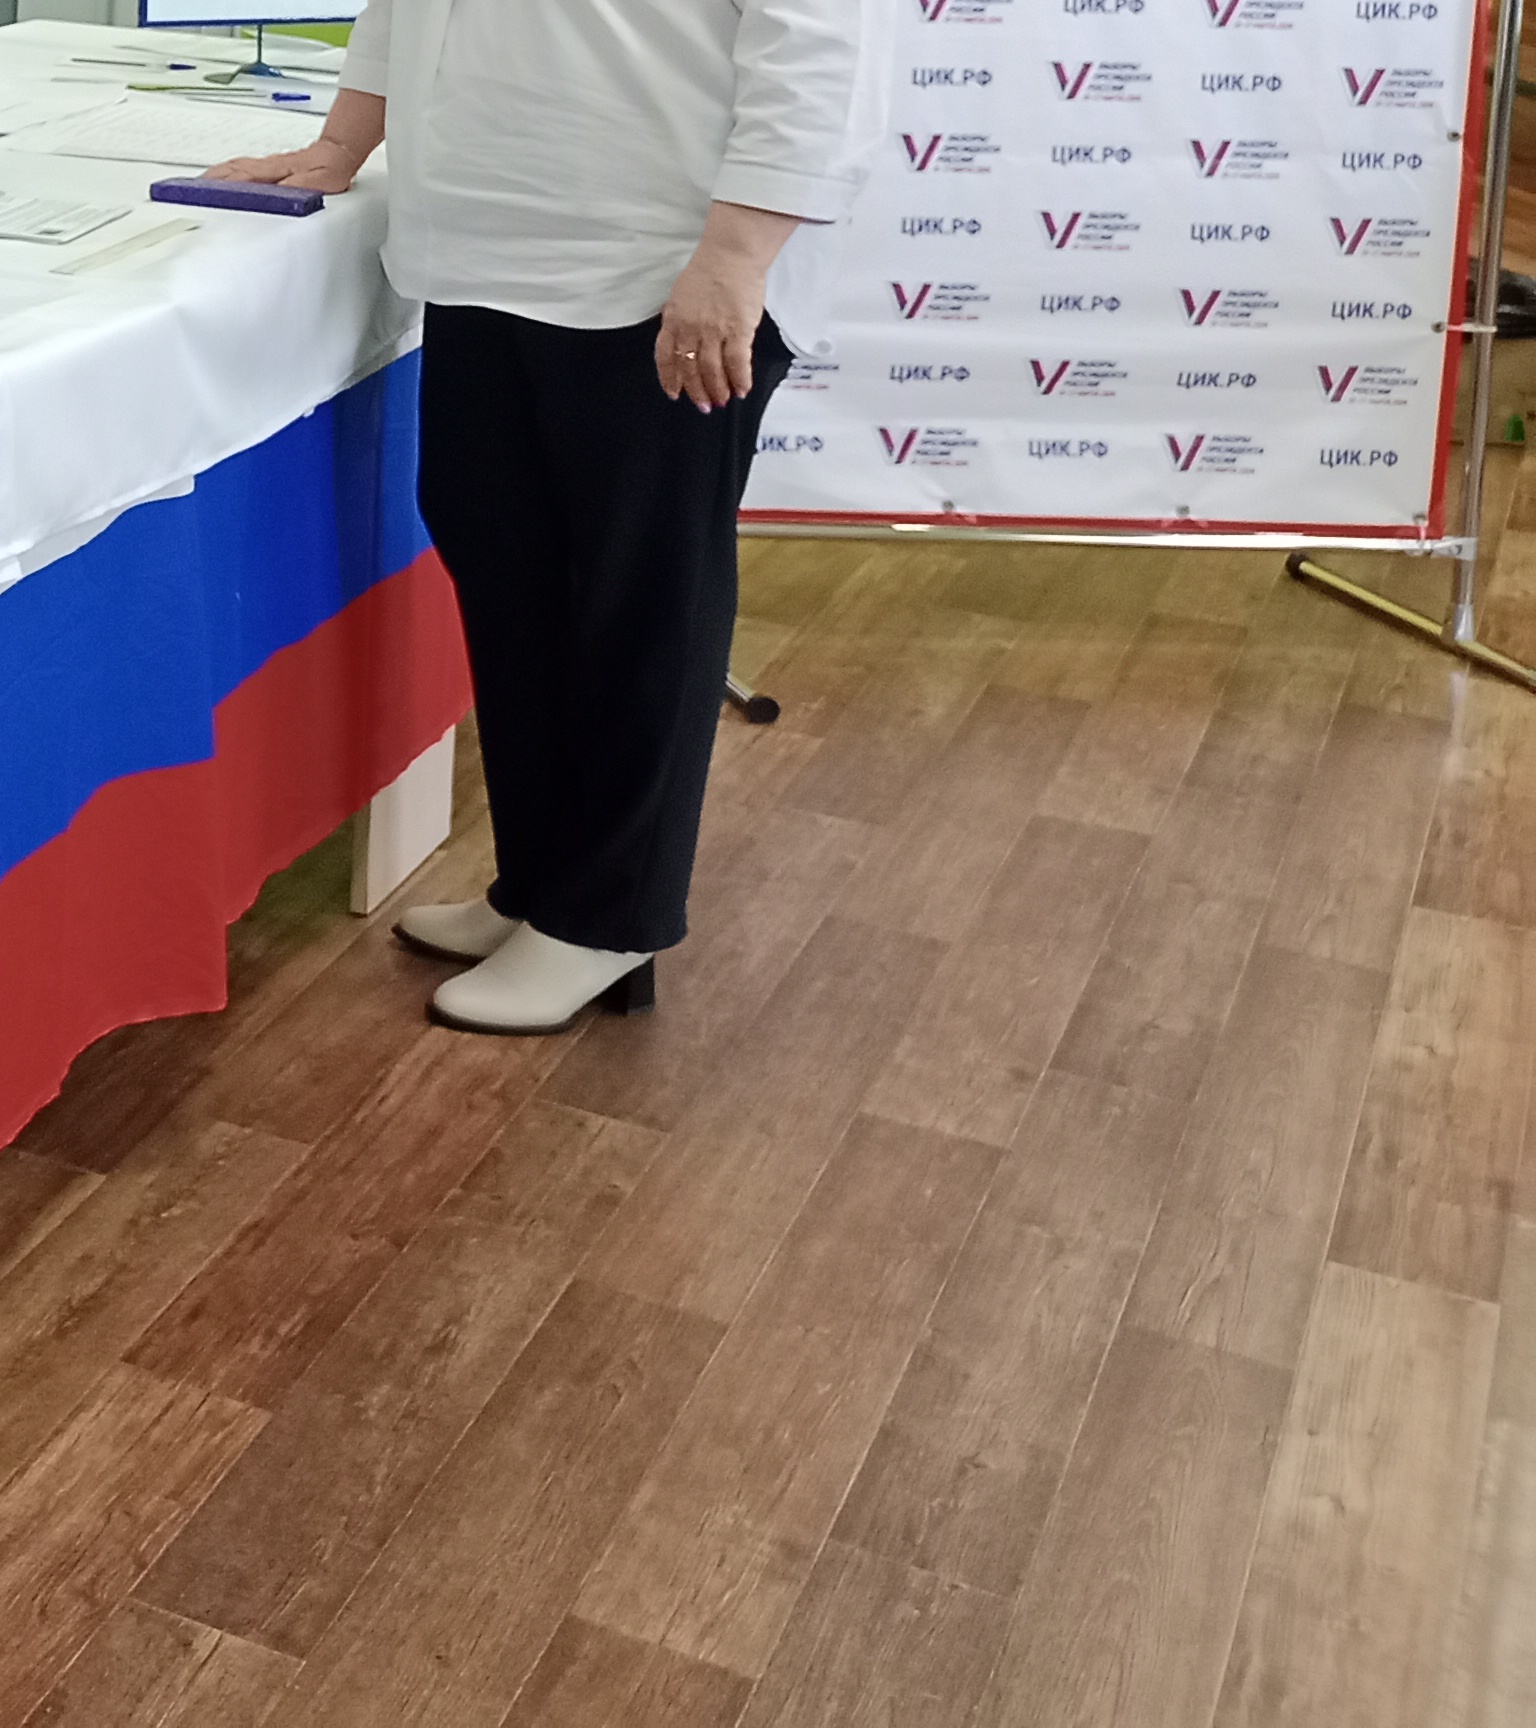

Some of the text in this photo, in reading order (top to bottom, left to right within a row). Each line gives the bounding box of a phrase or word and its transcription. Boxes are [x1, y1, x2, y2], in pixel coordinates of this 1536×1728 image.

[1356, 1, 1438, 23] ЦИК.РФ
[911, 67, 993, 88] ЦИК.РФ
[1201, 74, 1283, 94] ЦИК.РФ
[1051, 145, 1132, 166] ЦИК.РФ
[1342, 152, 1423, 172] ЦИК.РФ
[901, 217, 982, 237] ЦИК.РФ
[1190, 224, 1271, 244] ЦИК.РФ
[1040, 294, 1122, 315] ЦИК.РФ
[1331, 301, 1412, 321] ЦИК.РФ
[889, 365, 971, 384] ЦИК.РФ
[1176, 372, 1257, 390] ЦИК.РФ
[1028, 440, 1108, 460] ЦИК.РФ
[1320, 449, 1398, 469] ЦИК.РФ
